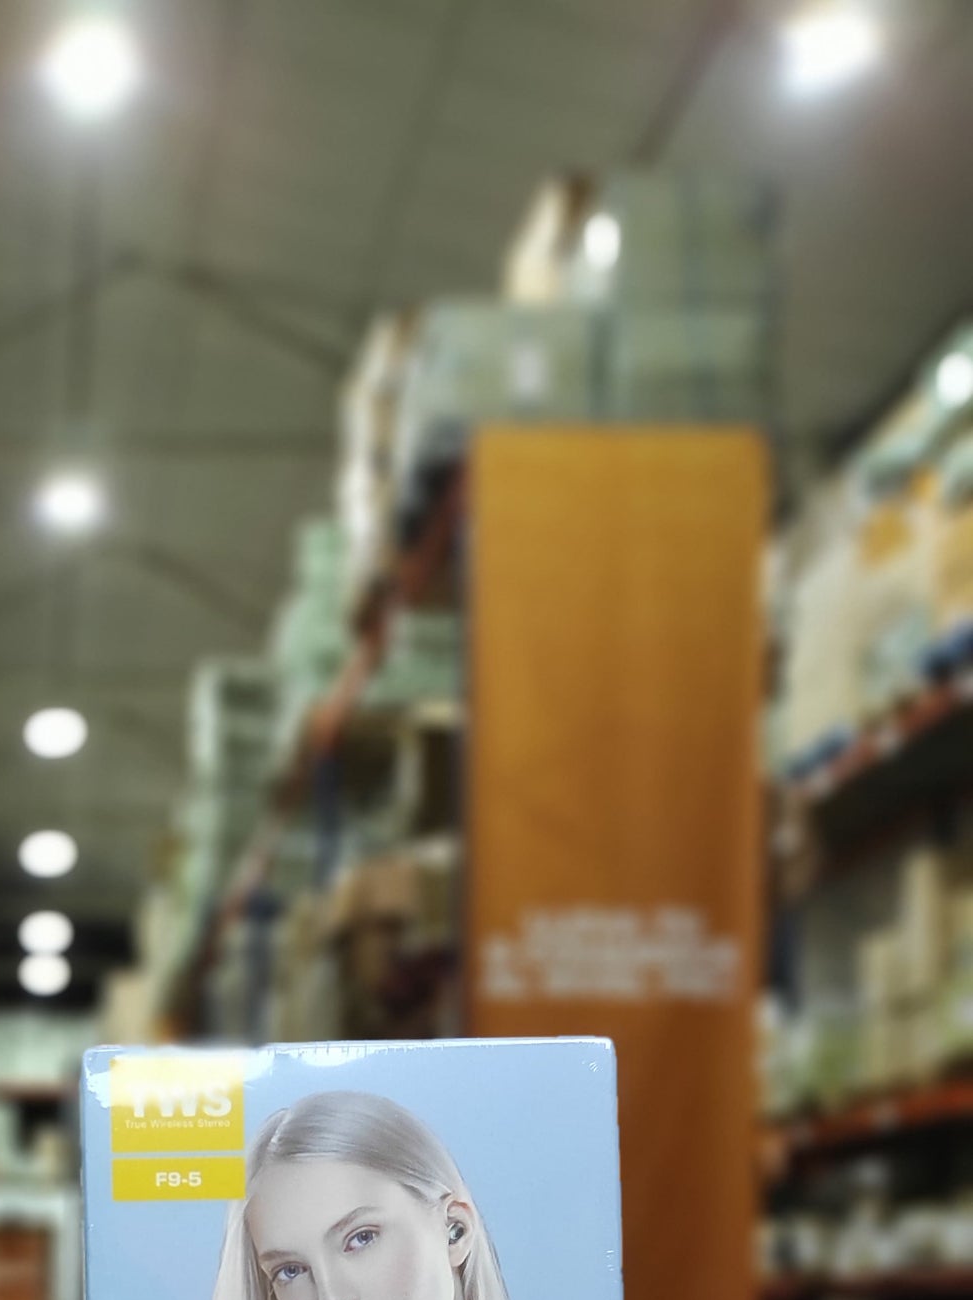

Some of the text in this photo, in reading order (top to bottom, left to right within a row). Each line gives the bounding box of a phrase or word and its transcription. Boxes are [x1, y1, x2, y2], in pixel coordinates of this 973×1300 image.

[125, 1118, 231, 1129] True Wireless Stereo
[155, 1171, 202, 1187] F9-5
